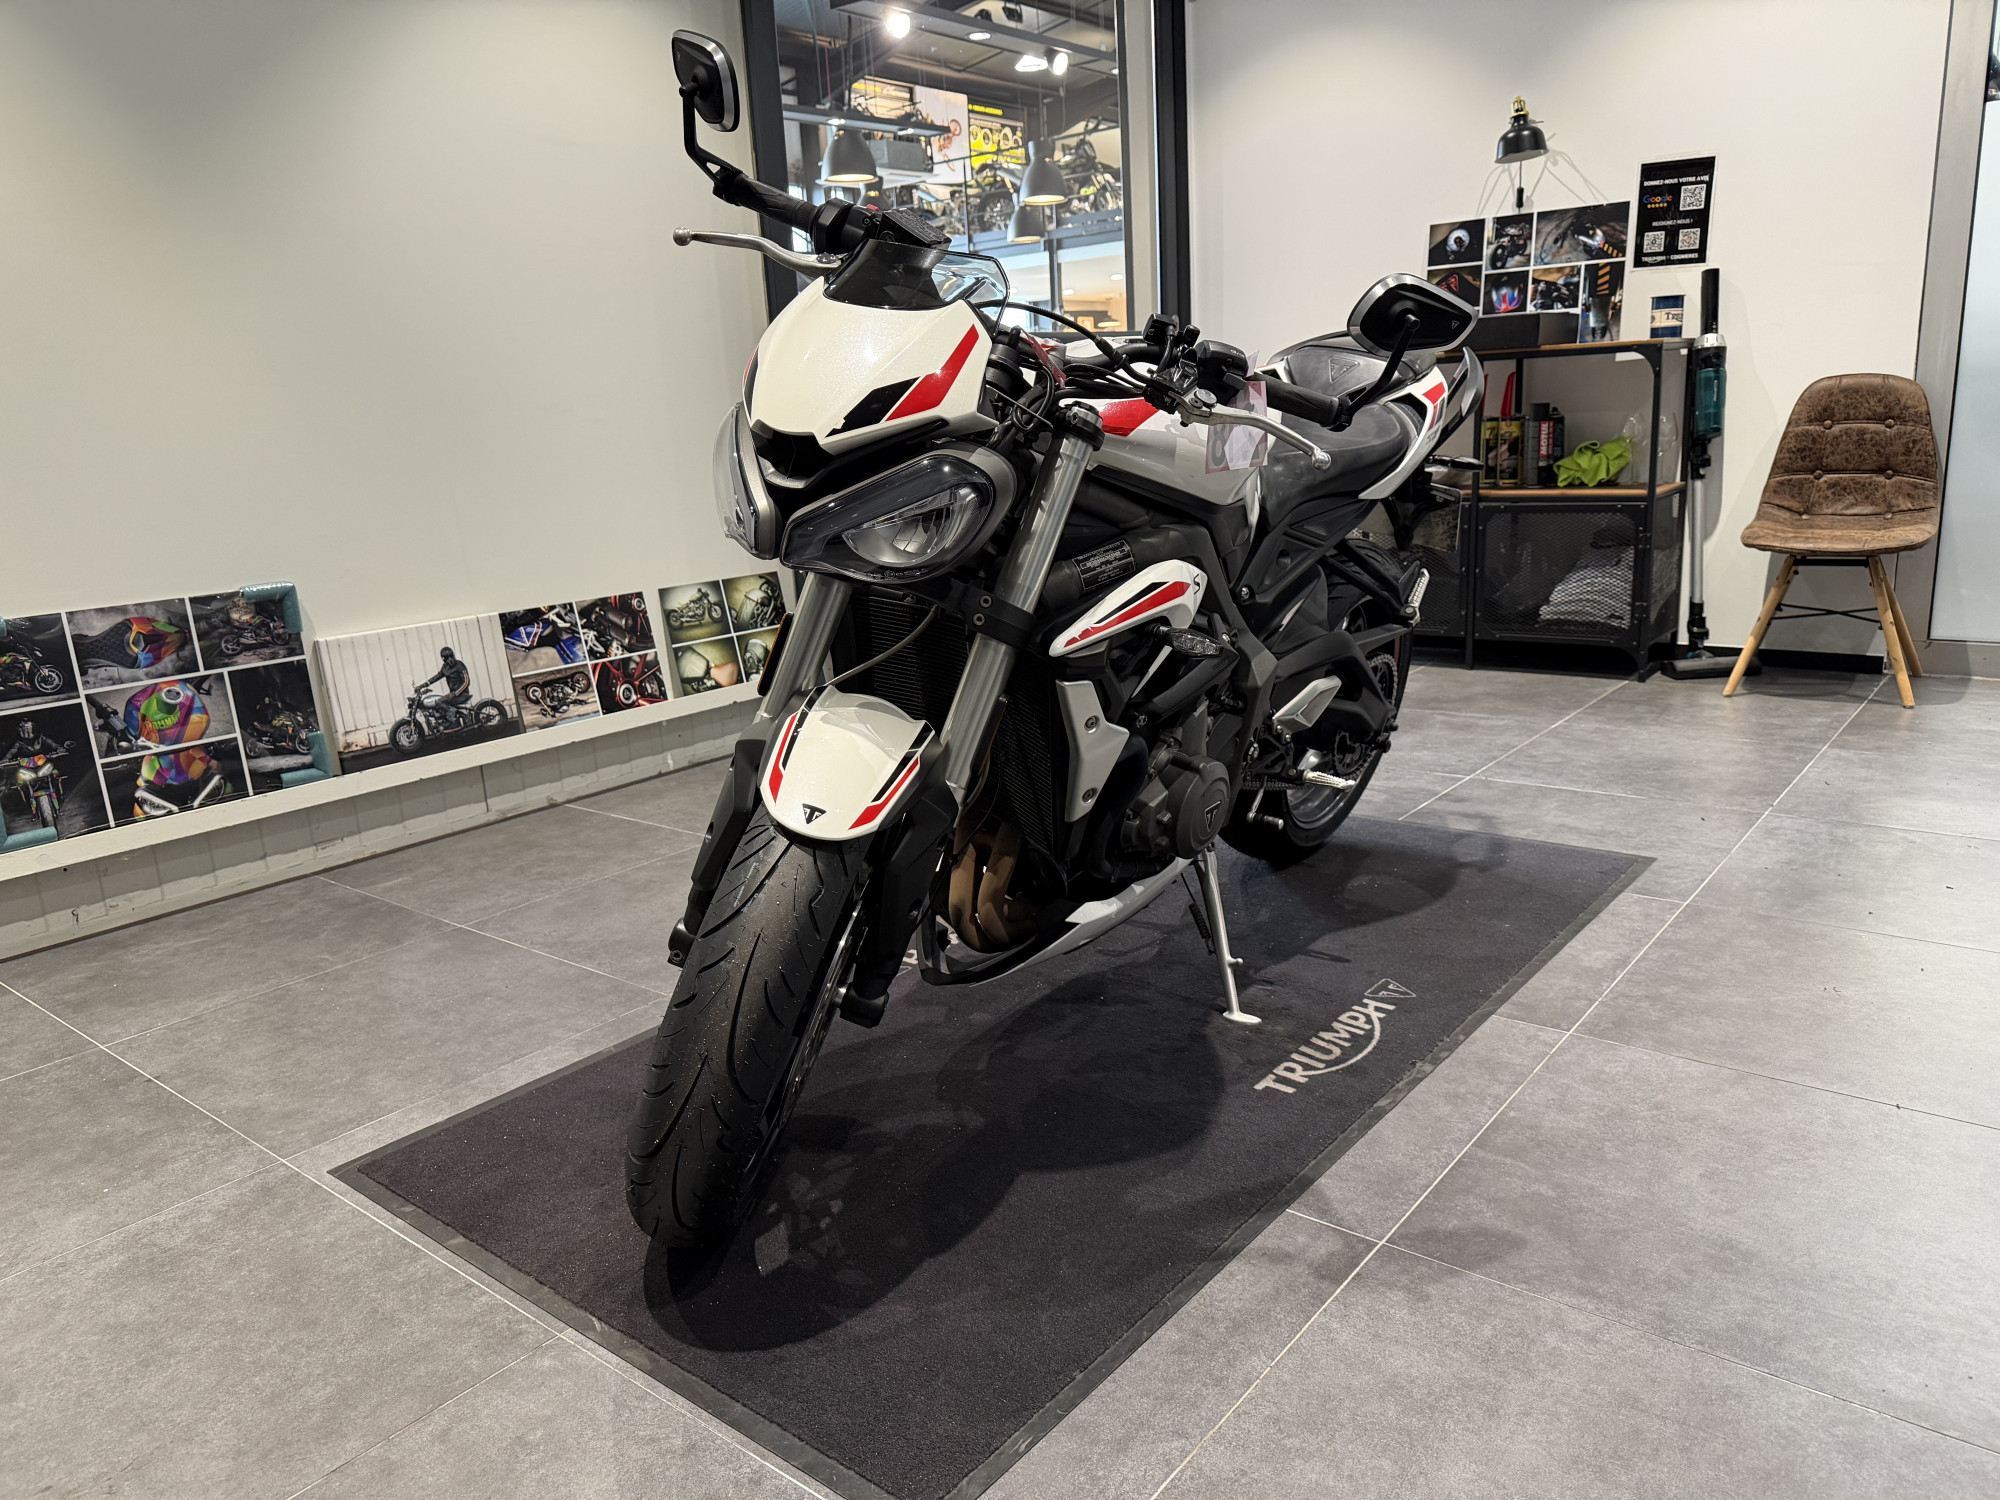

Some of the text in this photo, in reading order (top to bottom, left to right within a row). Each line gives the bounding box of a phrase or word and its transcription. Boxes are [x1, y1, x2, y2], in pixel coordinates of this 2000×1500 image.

[1643, 194, 1673, 204] Google
[1541, 424, 1549, 455] MOTUL
[1253, 998, 1396, 1094] TRIUMPH
